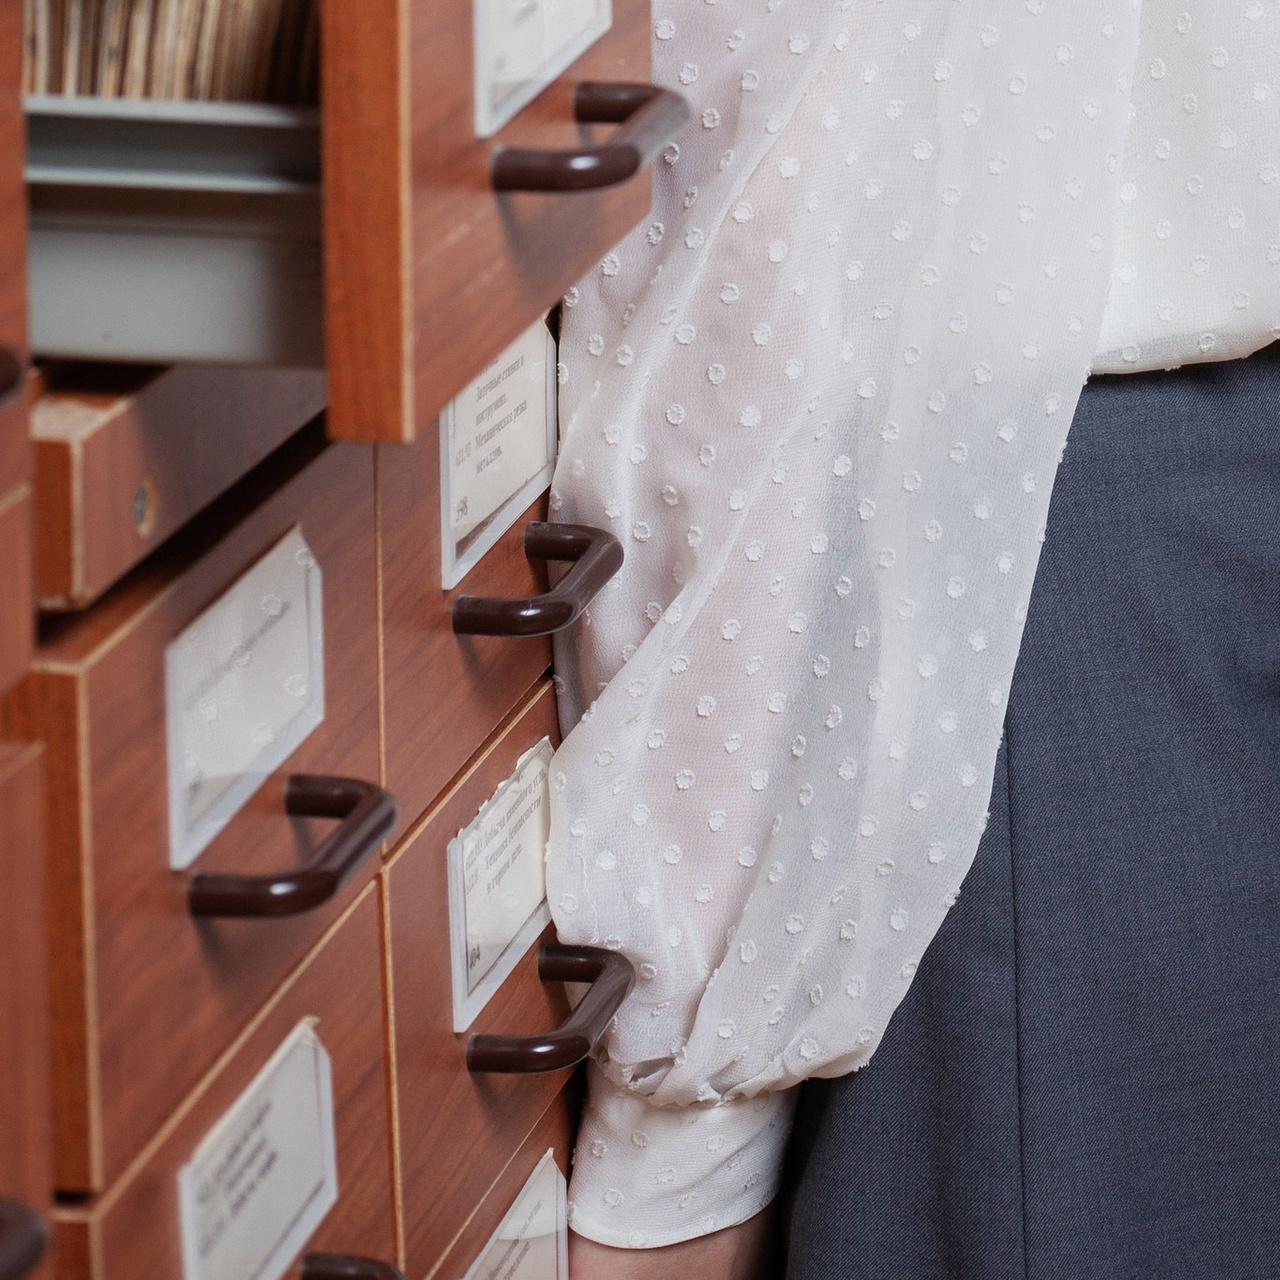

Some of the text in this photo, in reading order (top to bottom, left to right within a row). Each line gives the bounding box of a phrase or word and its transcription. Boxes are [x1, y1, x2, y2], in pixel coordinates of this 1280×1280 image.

[502, 361, 519, 384] станки
[474, 414, 513, 449] Механическая
[514, 400, 528, 426] резка
[485, 840, 508, 870] Техника
